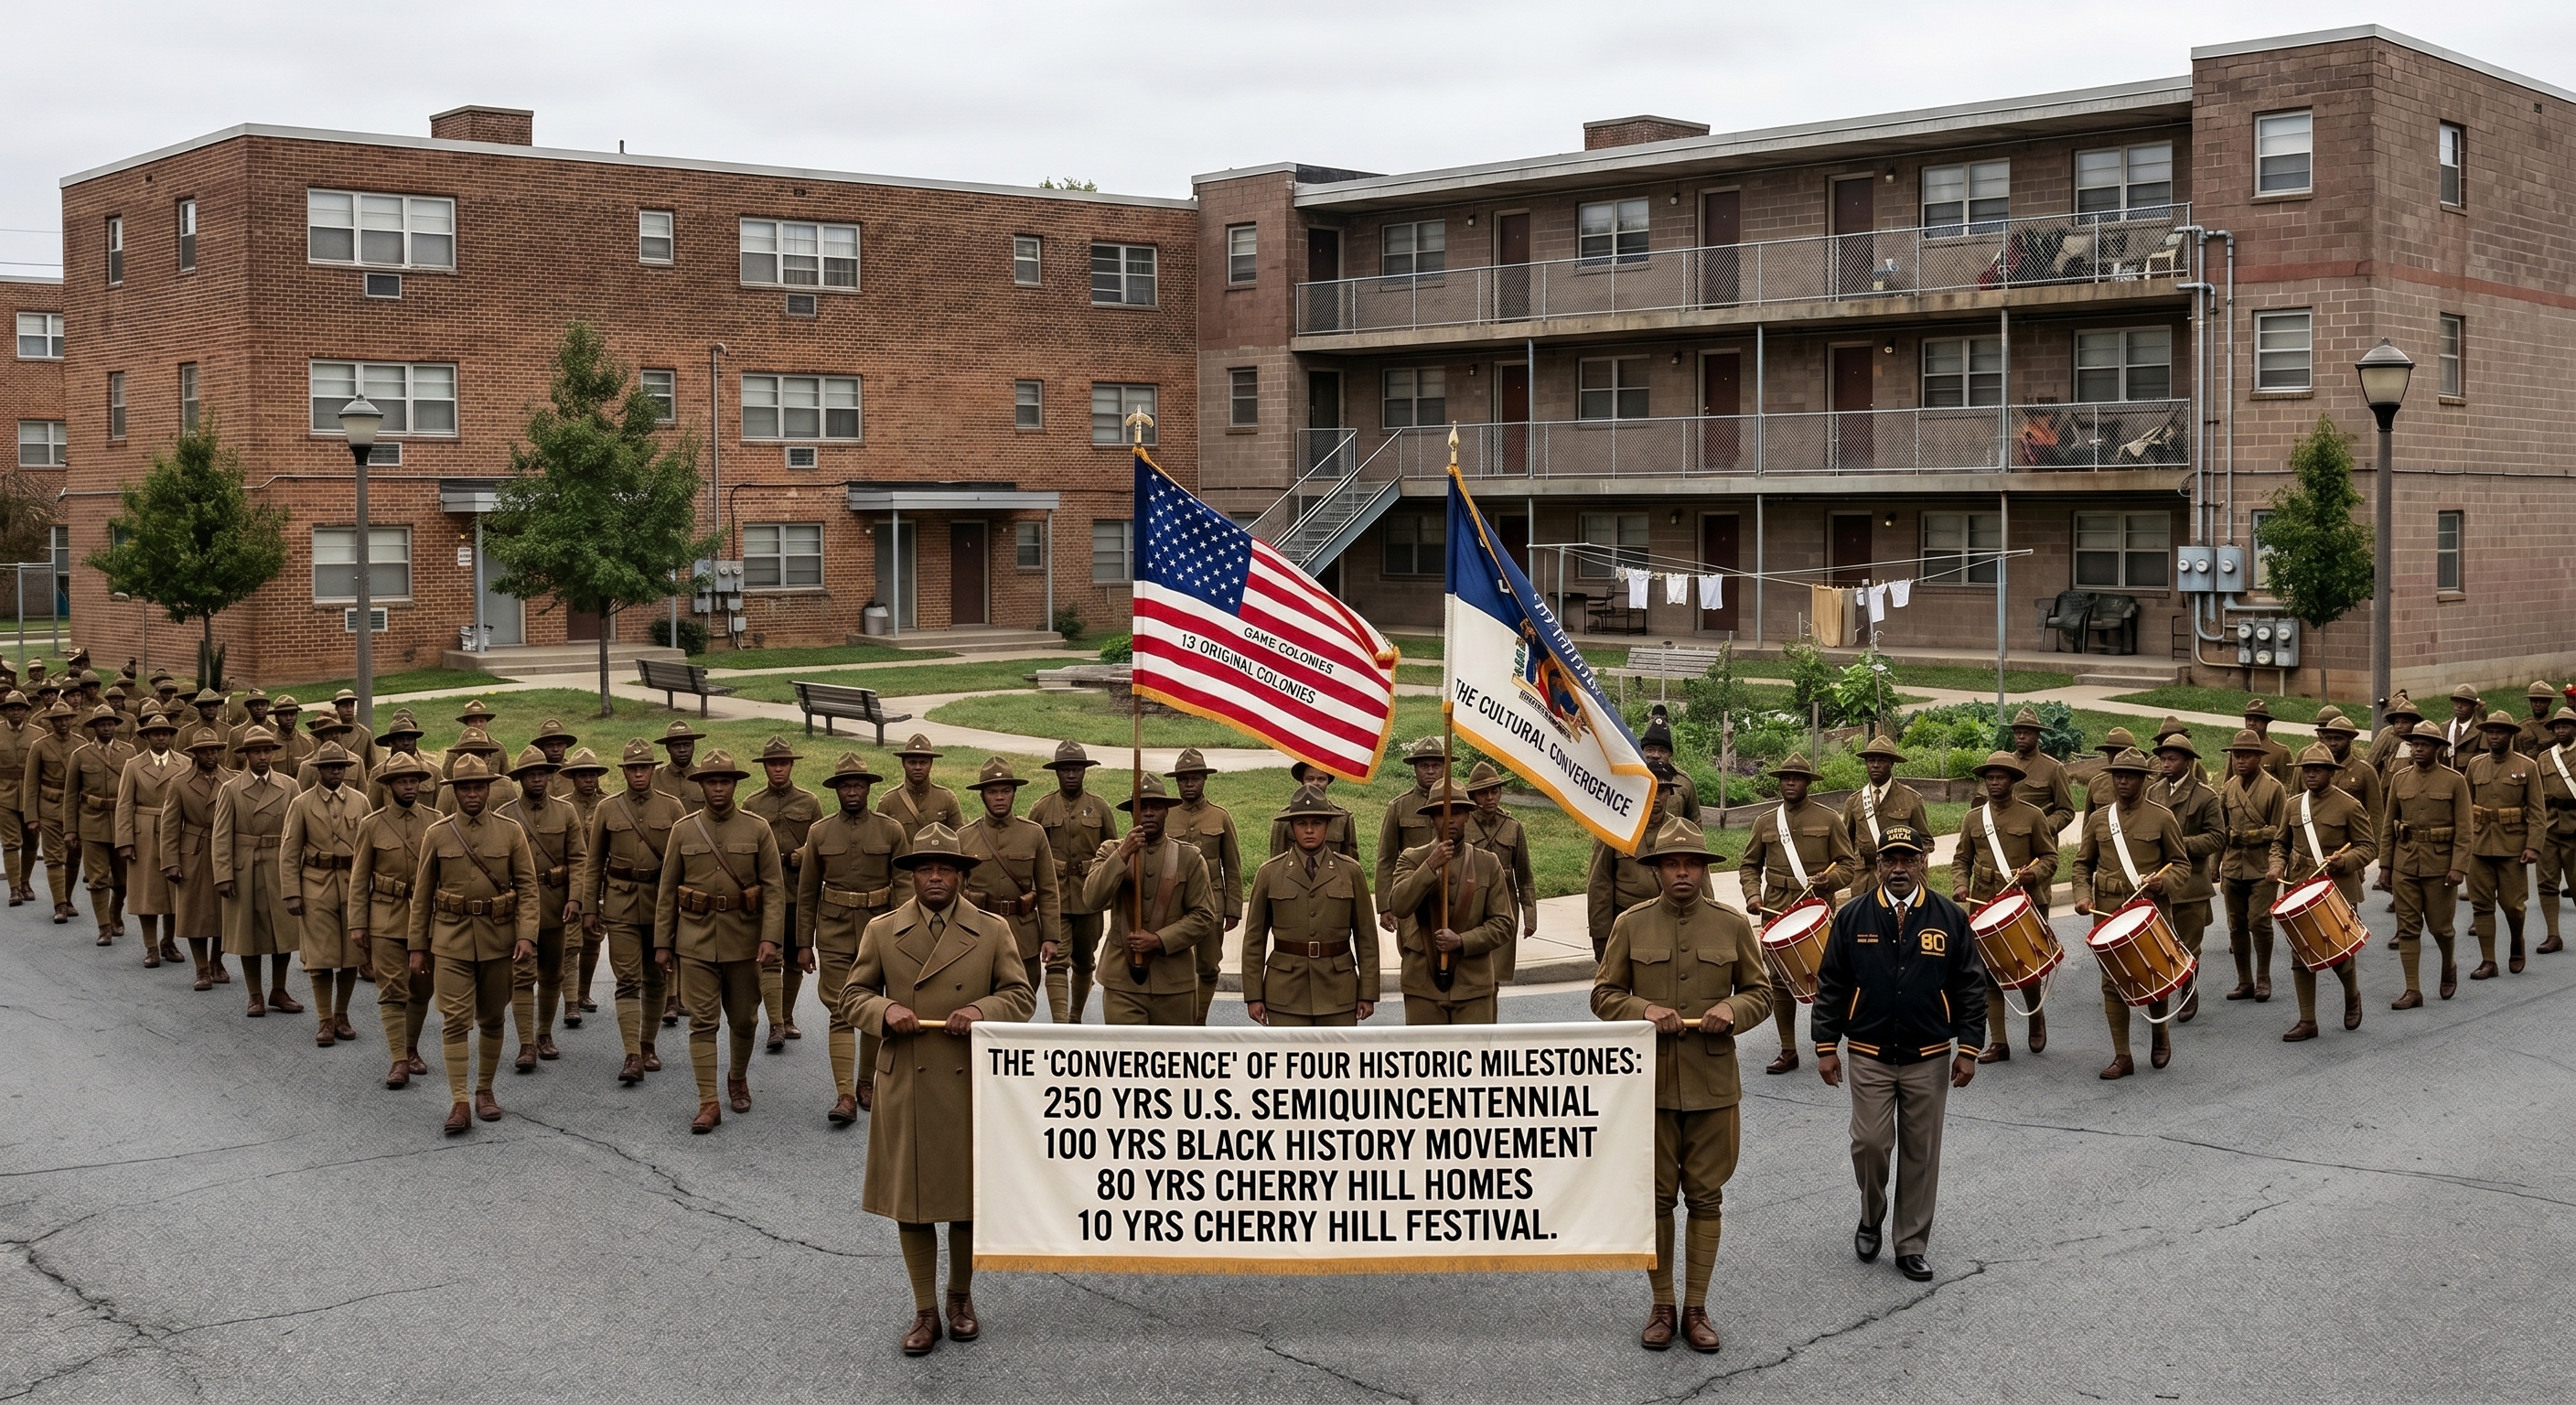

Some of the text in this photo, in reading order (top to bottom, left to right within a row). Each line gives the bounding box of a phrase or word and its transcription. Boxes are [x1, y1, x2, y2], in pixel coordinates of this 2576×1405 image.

[1182, 634, 1315, 704] 13 ORIGINAL COLONIES
[1244, 627, 1334, 675] GAME COLONIES
[1455, 677, 1479, 708] THE
[1478, 695, 1546, 753] CULTURAL
[1550, 742, 1634, 818] CONVERGENCE
[1921, 933, 1946, 952] 80
[987, 1047, 1035, 1077] THE
[1247, 1051, 1278, 1079] OF
[1286, 1051, 1350, 1079] FOUR
[1359, 1050, 1473, 1078] HISTORIC
[1481, 1046, 1644, 1078] MILESTONES:
[1044, 1085, 1599, 1122] 250 YRS U.S. SEMIQUINCENTENNIAL
[1044, 1126, 1598, 1162] 100 YRS BLACK HISTORY MOVEMENT
[1097, 1167, 1533, 1202] 80 YRS CHERRY HILL HOMES
[1078, 1208, 1558, 1242] 10 YRS CHERRY HILL FESTIVAL.
